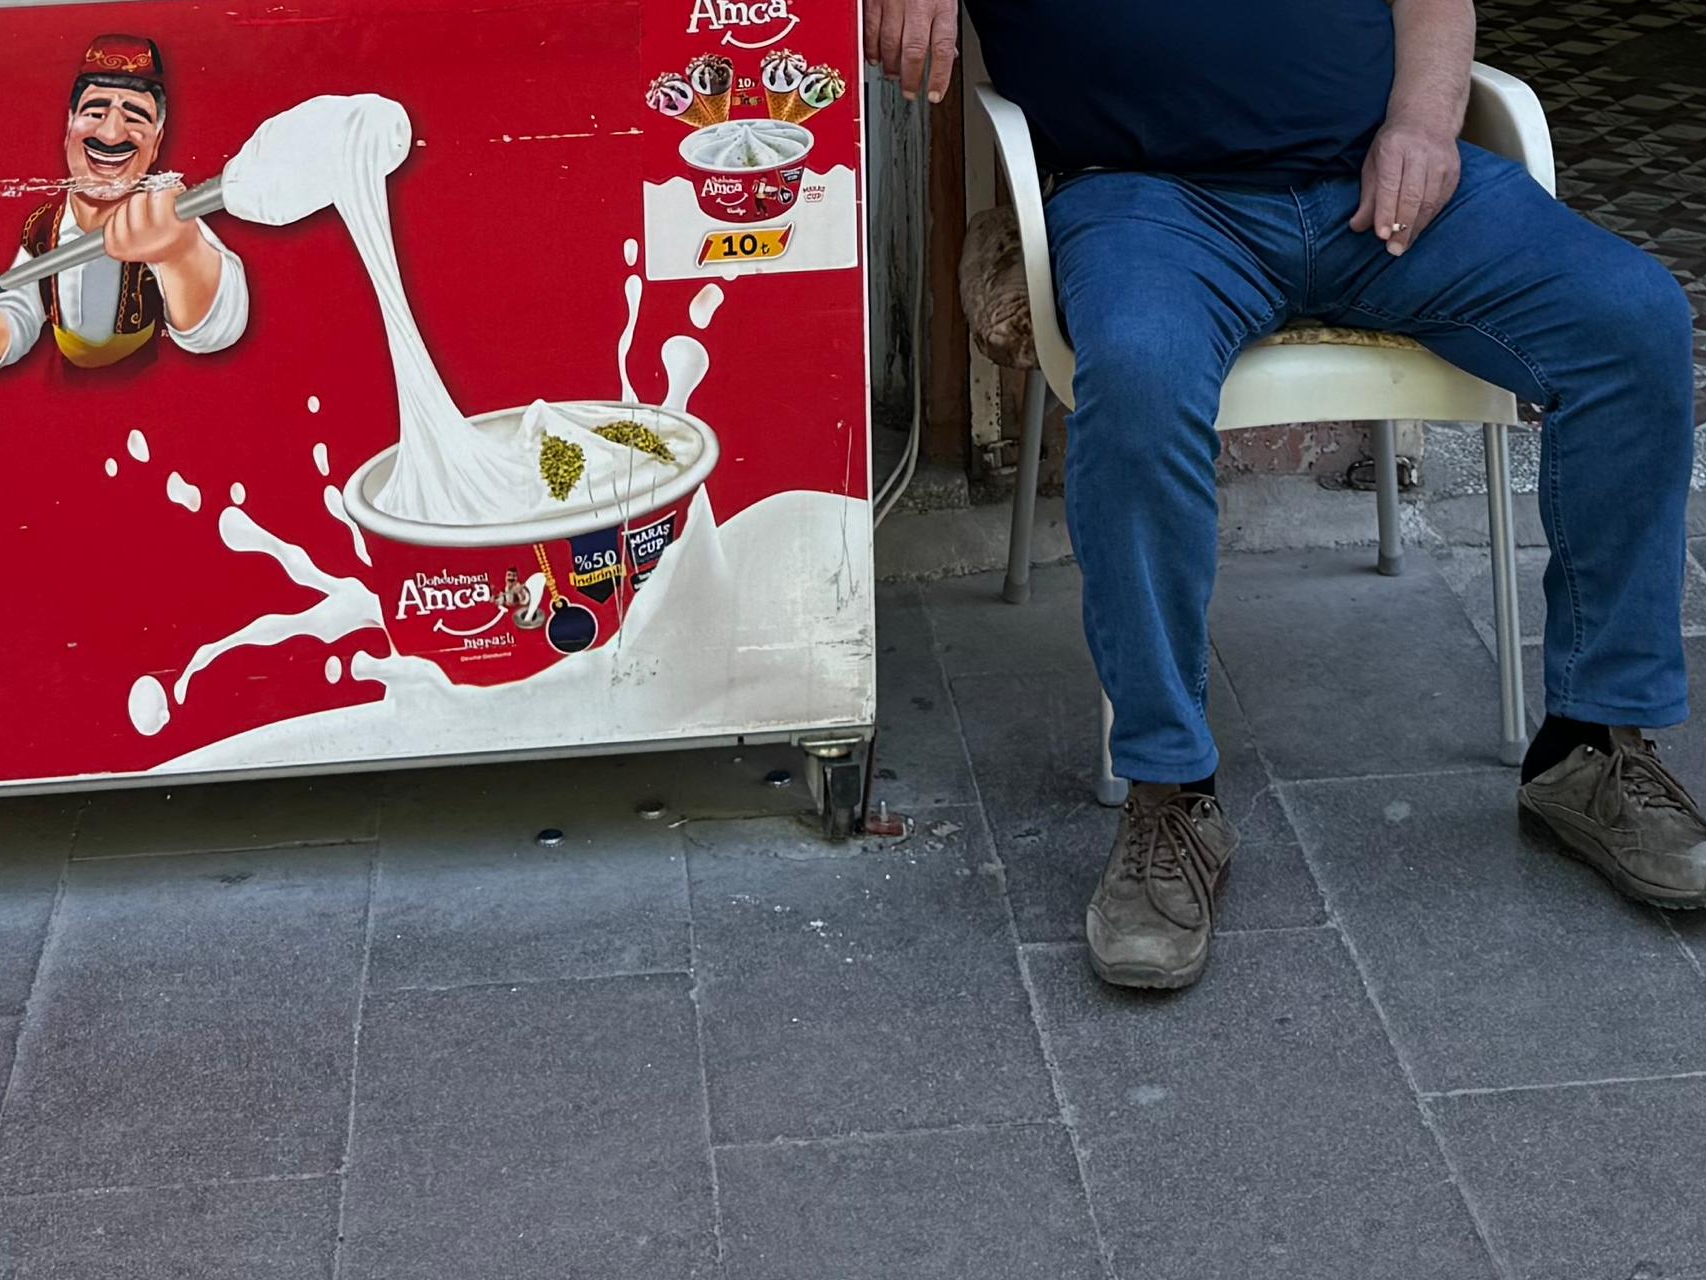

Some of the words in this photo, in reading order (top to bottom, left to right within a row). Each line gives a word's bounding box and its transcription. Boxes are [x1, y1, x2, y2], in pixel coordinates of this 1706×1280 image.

[701, 179, 743, 197] Amca
[638, 538, 664, 557] CUP
[574, 550, 617, 571] %50
[395, 579, 491, 620] Amca
